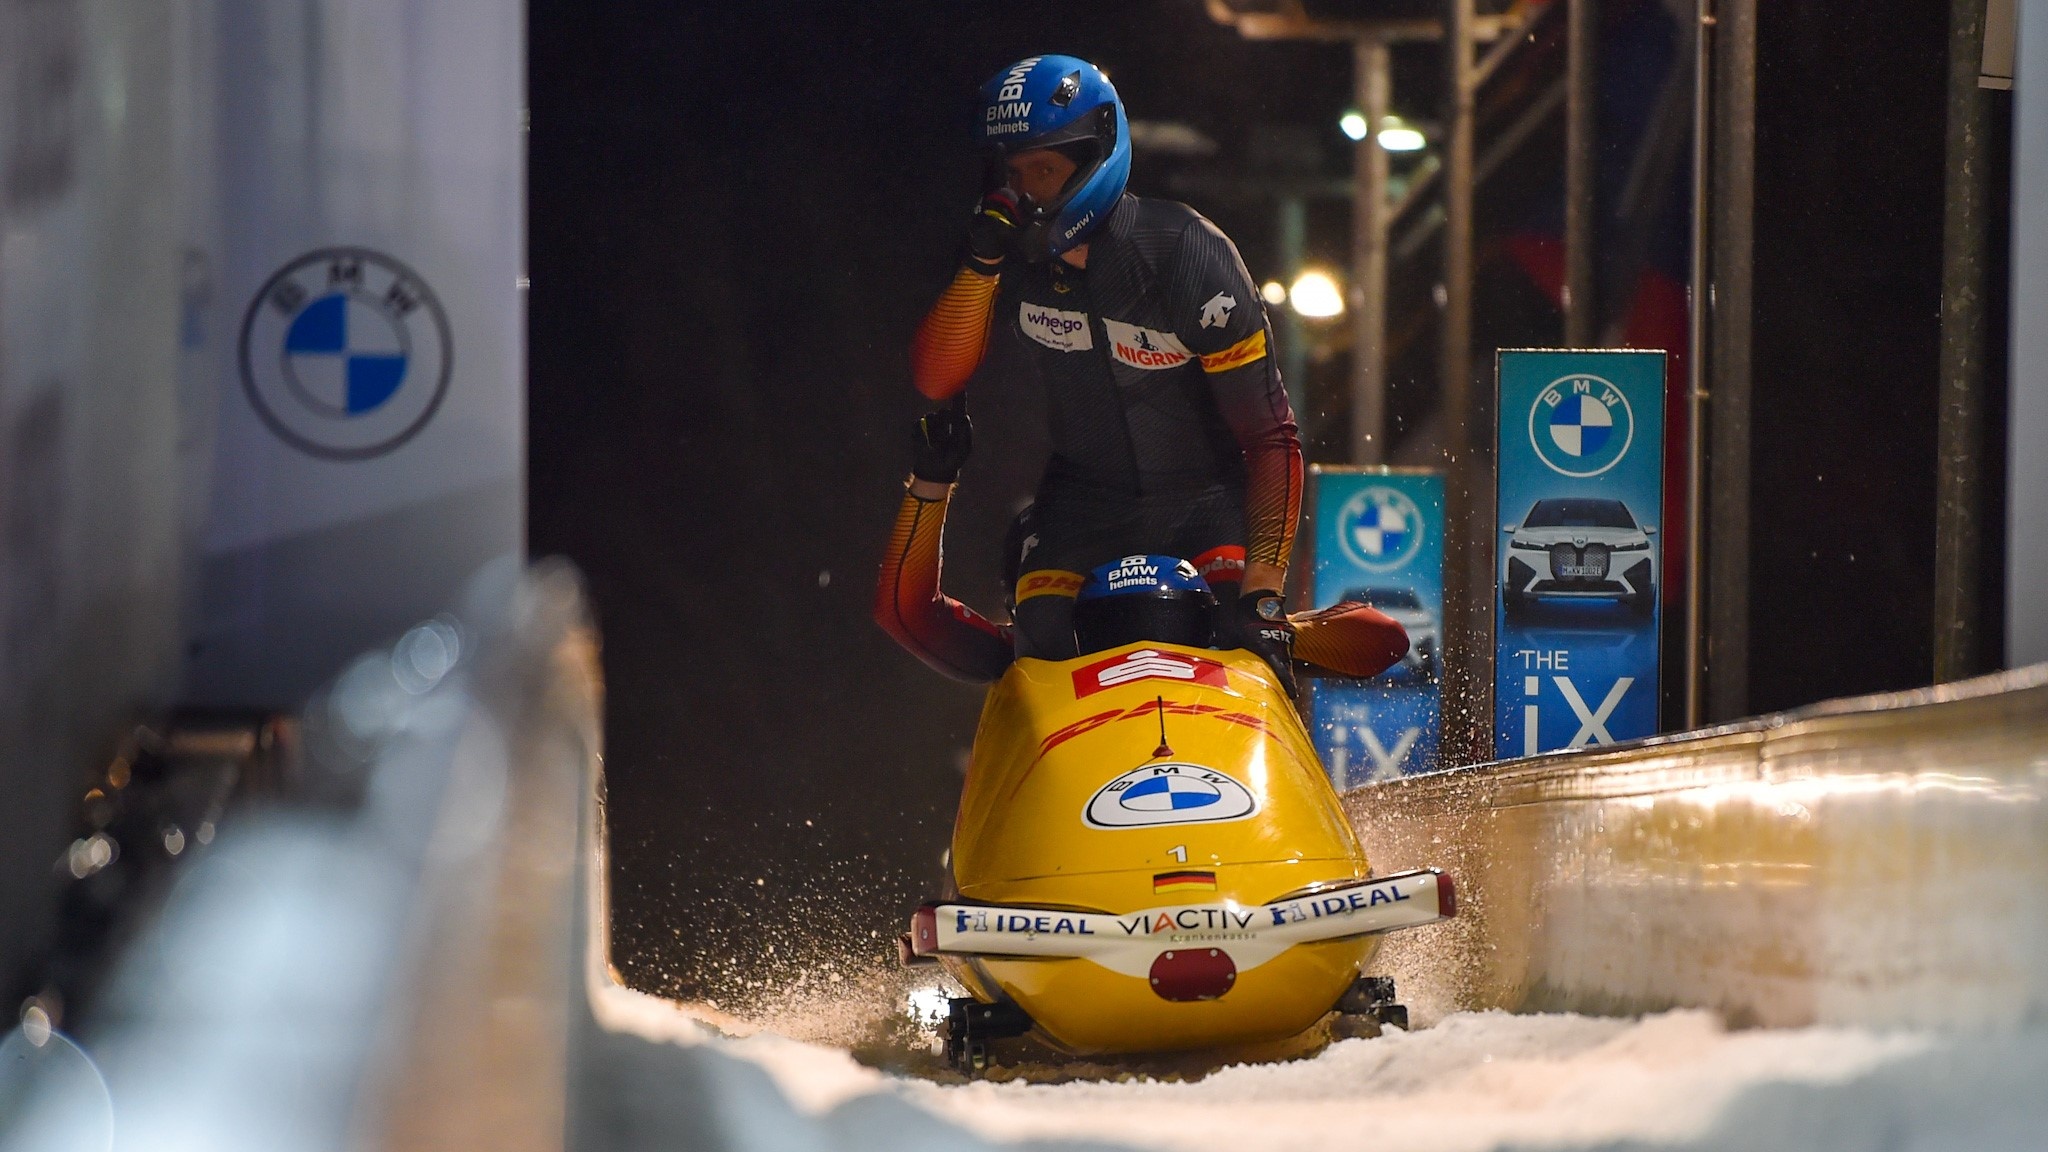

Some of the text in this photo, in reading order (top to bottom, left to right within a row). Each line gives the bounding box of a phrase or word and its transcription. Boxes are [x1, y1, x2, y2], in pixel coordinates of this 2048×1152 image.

[986, 102, 1033, 122] BMW
[986, 120, 1030, 136] helmets
[1064, 213, 1090, 240] BMW
[1116, 342, 1186, 366] NIGRIN
[1543, 379, 1620, 408] BMW
[1108, 565, 1159, 582] BMW
[1109, 576, 1158, 591] helmets
[1519, 650, 1569, 670] THE
[1524, 676, 1635, 757] iX
[1106, 766, 1229, 792] BMW
[1166, 845, 1188, 863] 1
[1312, 885, 1411, 918] IDEAL
[996, 914, 1095, 935] IDEAL
[1117, 909, 1254, 936] VIACTIV
